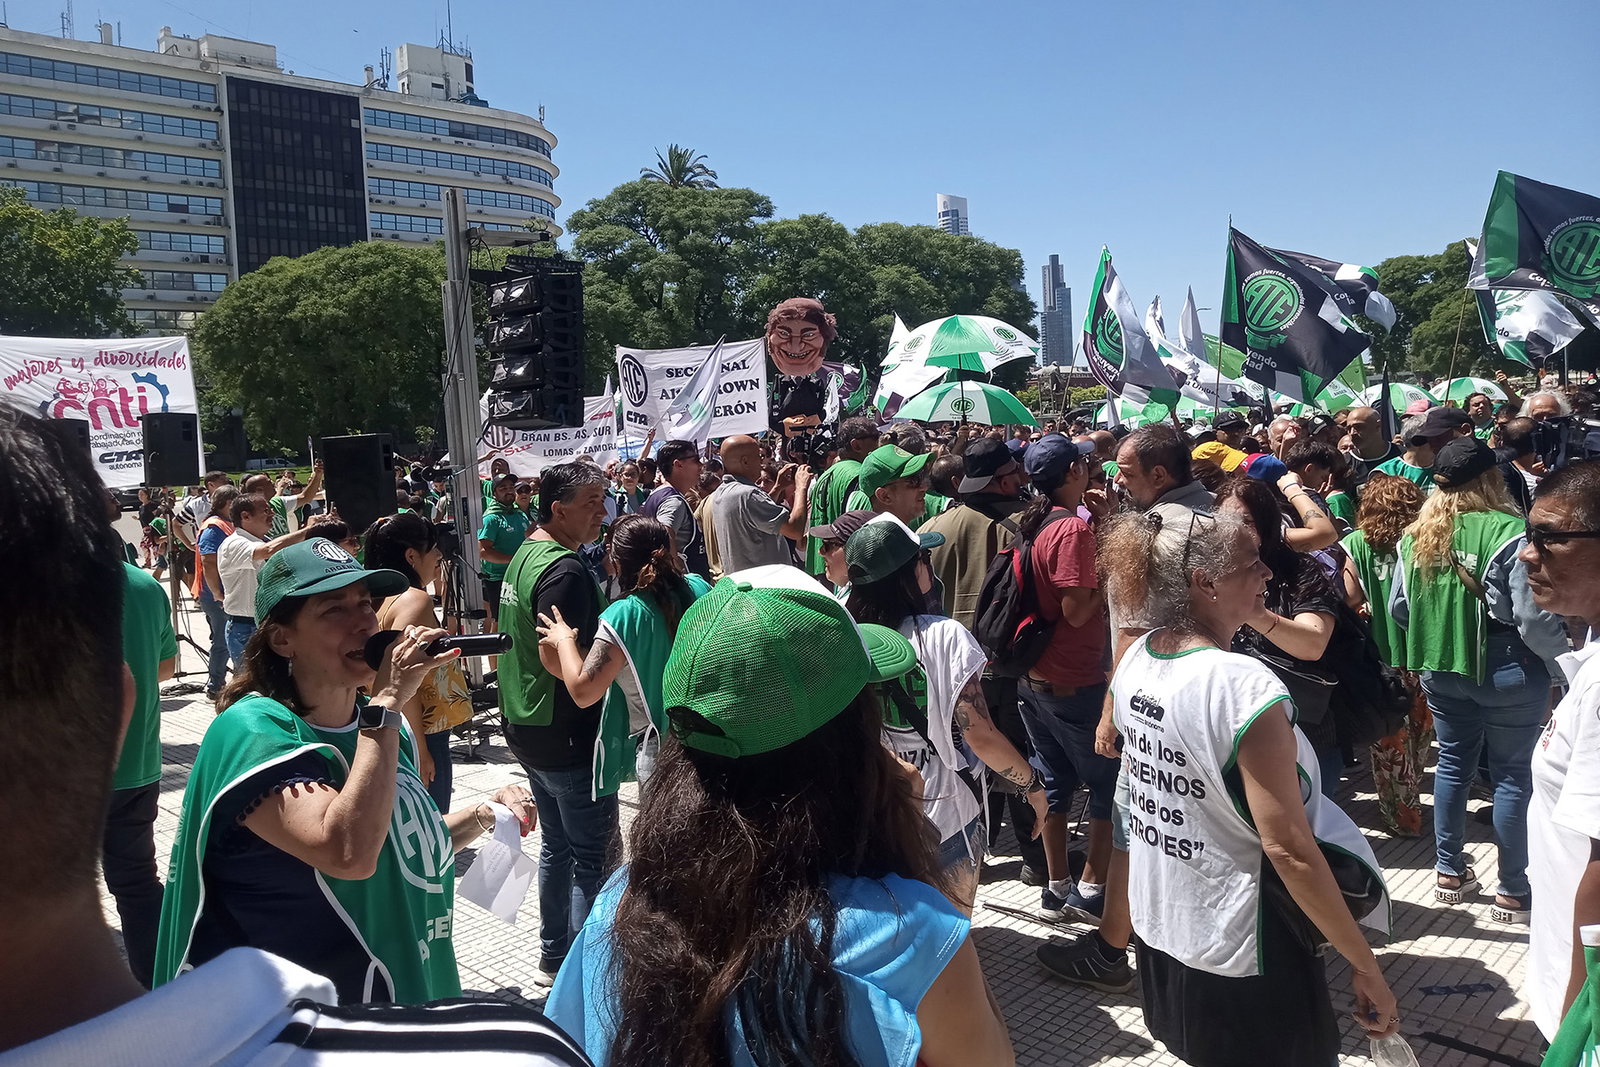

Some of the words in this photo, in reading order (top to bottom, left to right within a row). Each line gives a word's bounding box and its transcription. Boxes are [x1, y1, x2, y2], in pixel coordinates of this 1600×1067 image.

[1245, 279, 1294, 327] ATE
[3, 357, 64, 391] mujeres
[71, 357, 86, 374] y
[93, 350, 188, 371] diversidades
[665, 359, 750, 378] SECNAL
[717, 378, 760, 395] OWN
[626, 410, 648, 426] CTA
[713, 399, 757, 418] ERÓN
[521, 432, 551, 442] GRAN
[553, 432, 571, 442] BS.
[574, 429, 590, 440] AS.
[592, 425, 611, 437] SUR
[543, 447, 574, 457] LOMAS
[1138, 732, 1152, 757] de
[1158, 739, 1187, 767] los
[1126, 752, 1206, 800] OBIERNOS
[1139, 791, 1157, 815] de
[1157, 799, 1185, 827] los
[1129, 811, 1206, 861] ATRONES”
